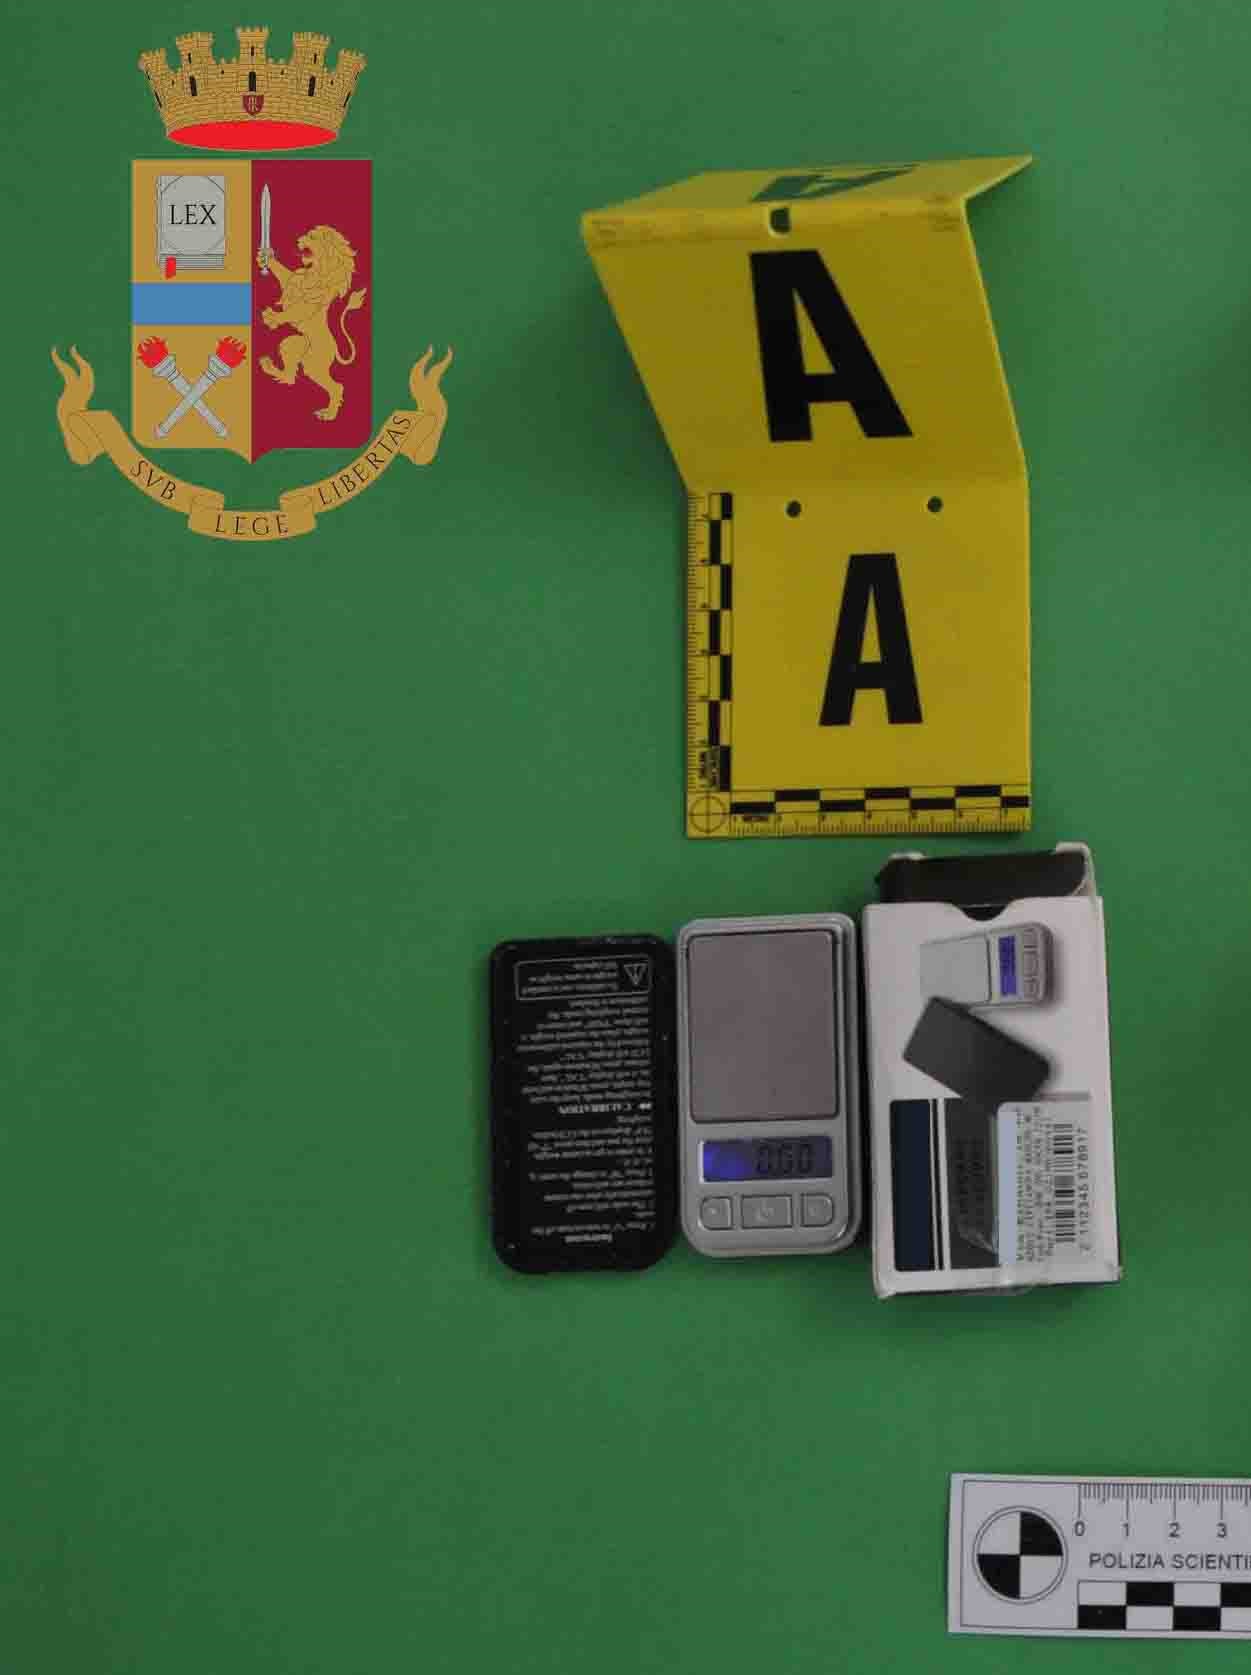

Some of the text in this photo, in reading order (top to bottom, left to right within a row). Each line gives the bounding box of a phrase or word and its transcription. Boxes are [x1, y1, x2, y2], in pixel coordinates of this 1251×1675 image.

[748, 249, 914, 442] A
[818, 553, 923, 726] A
[1075, 1522, 1086, 1537] 0
[1122, 1523, 1130, 1537] 1
[1168, 1523, 1181, 1538] 2
[1216, 1523, 1228, 1538] 3
[1089, 1553, 1166, 1570] POLIZIA
